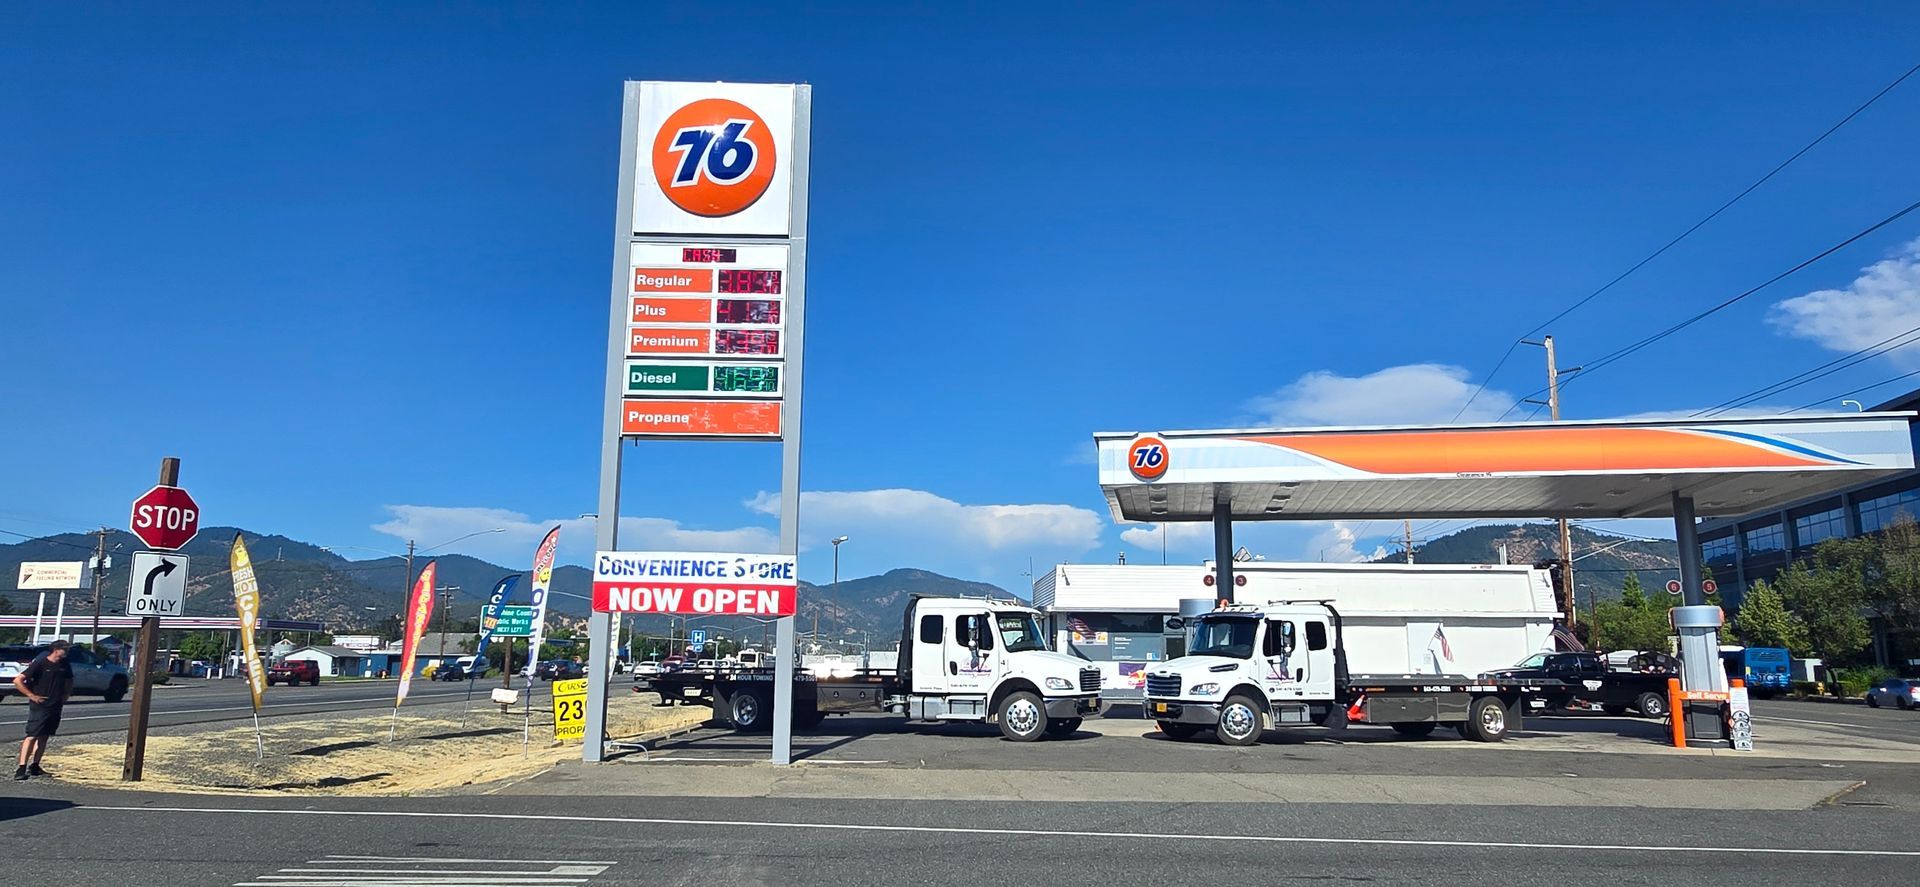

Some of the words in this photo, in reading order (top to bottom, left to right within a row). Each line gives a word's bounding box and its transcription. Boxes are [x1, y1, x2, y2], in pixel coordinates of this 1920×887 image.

[668, 118, 758, 188] 76
[683, 248, 721, 262] CASH
[636, 274, 693, 290] Regular
[634, 304, 667, 316] Plus
[633, 335, 699, 347] Premium
[631, 371, 677, 384] Diesel
[628, 410, 690, 425] Propane
[1133, 444, 1164, 468] 76
[136, 504, 196, 531] STOP
[599, 555, 728, 577] CONVENIENCE
[734, 558, 794, 579] STORE
[235, 580, 257, 597] HOT
[1671, 583, 1677, 591] 6
[1707, 583, 1713, 591] 5
[136, 598, 178, 612] ONLY
[487, 583, 507, 616] ICE
[608, 587, 684, 612] NOW
[692, 588, 780, 613] OPEN
[693, 632, 703, 642] H
[558, 699, 587, 722] 23
